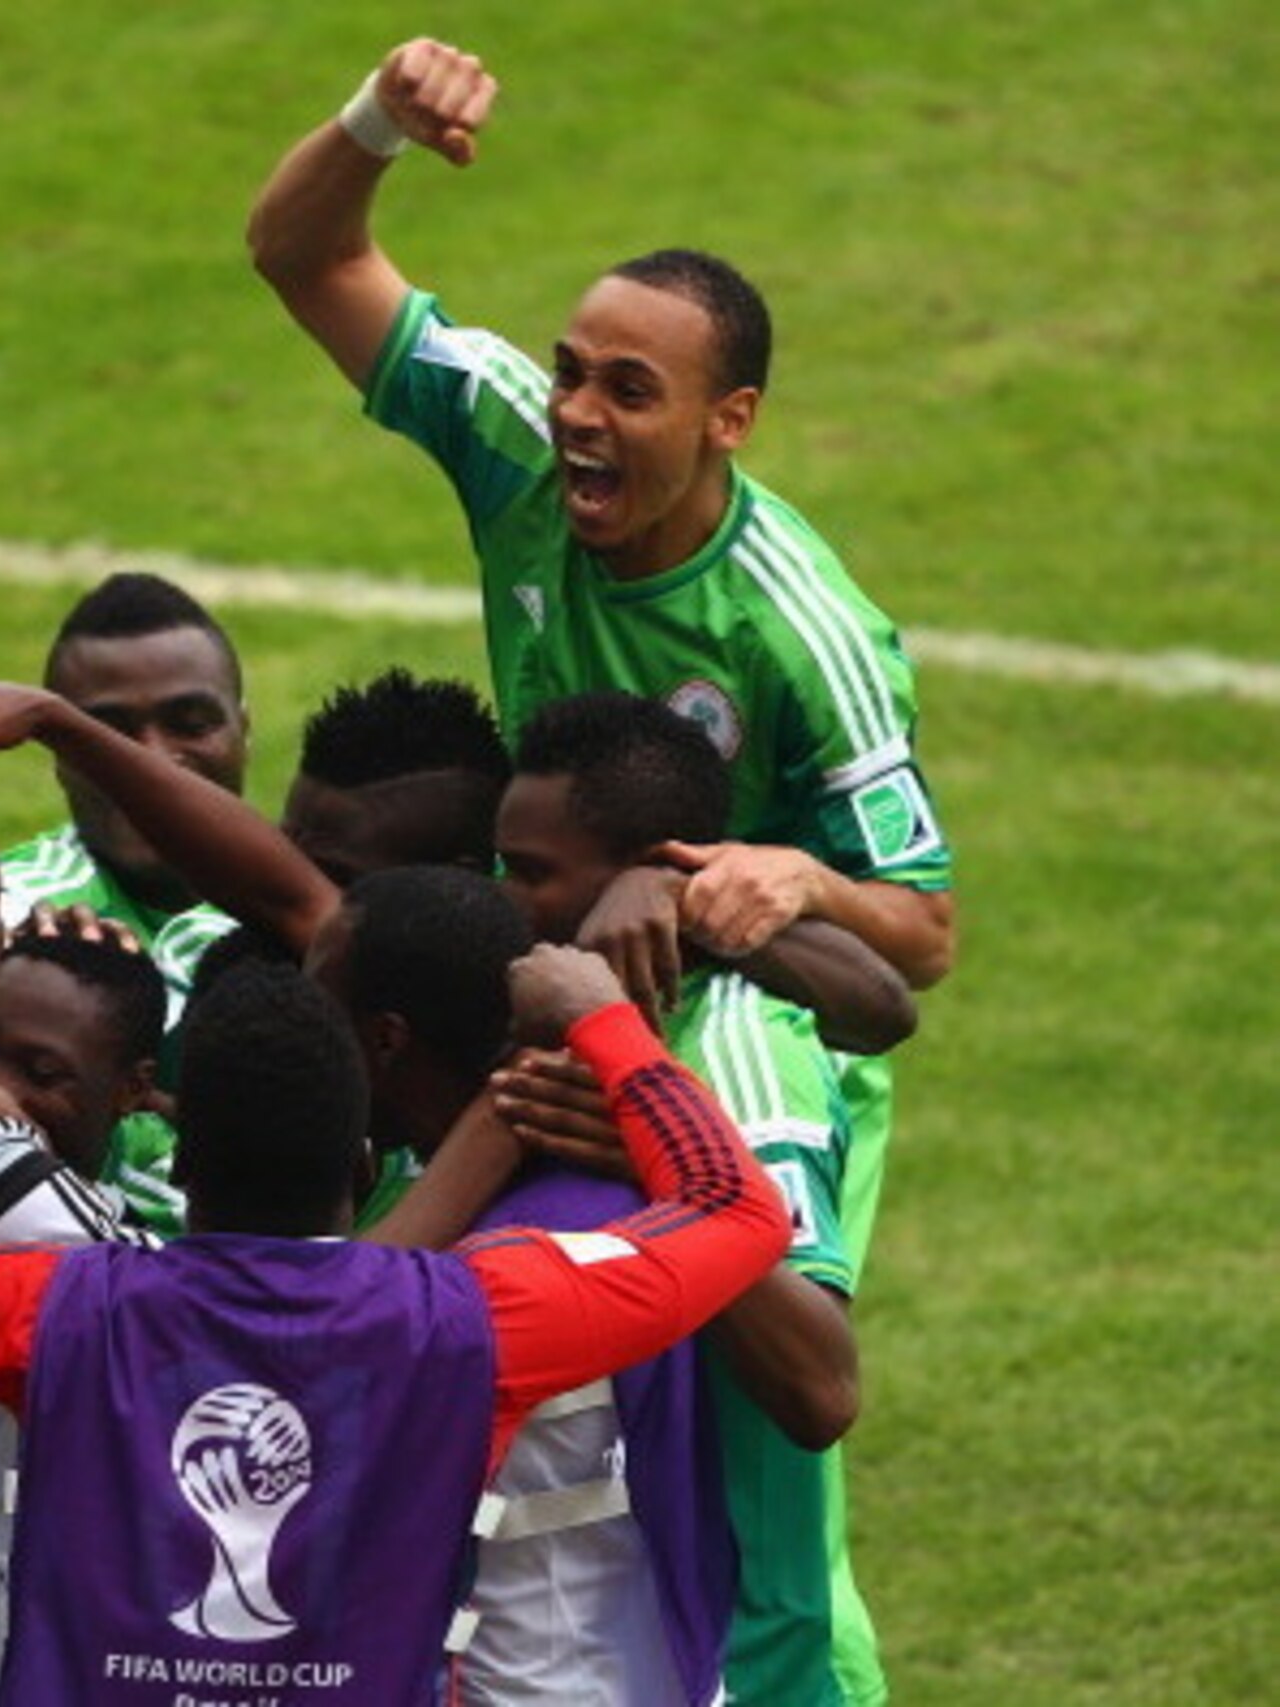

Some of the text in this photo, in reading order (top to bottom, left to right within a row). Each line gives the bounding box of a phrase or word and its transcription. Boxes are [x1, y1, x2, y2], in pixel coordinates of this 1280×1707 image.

[105, 1653, 354, 1687] FIFA WORLD CUP
